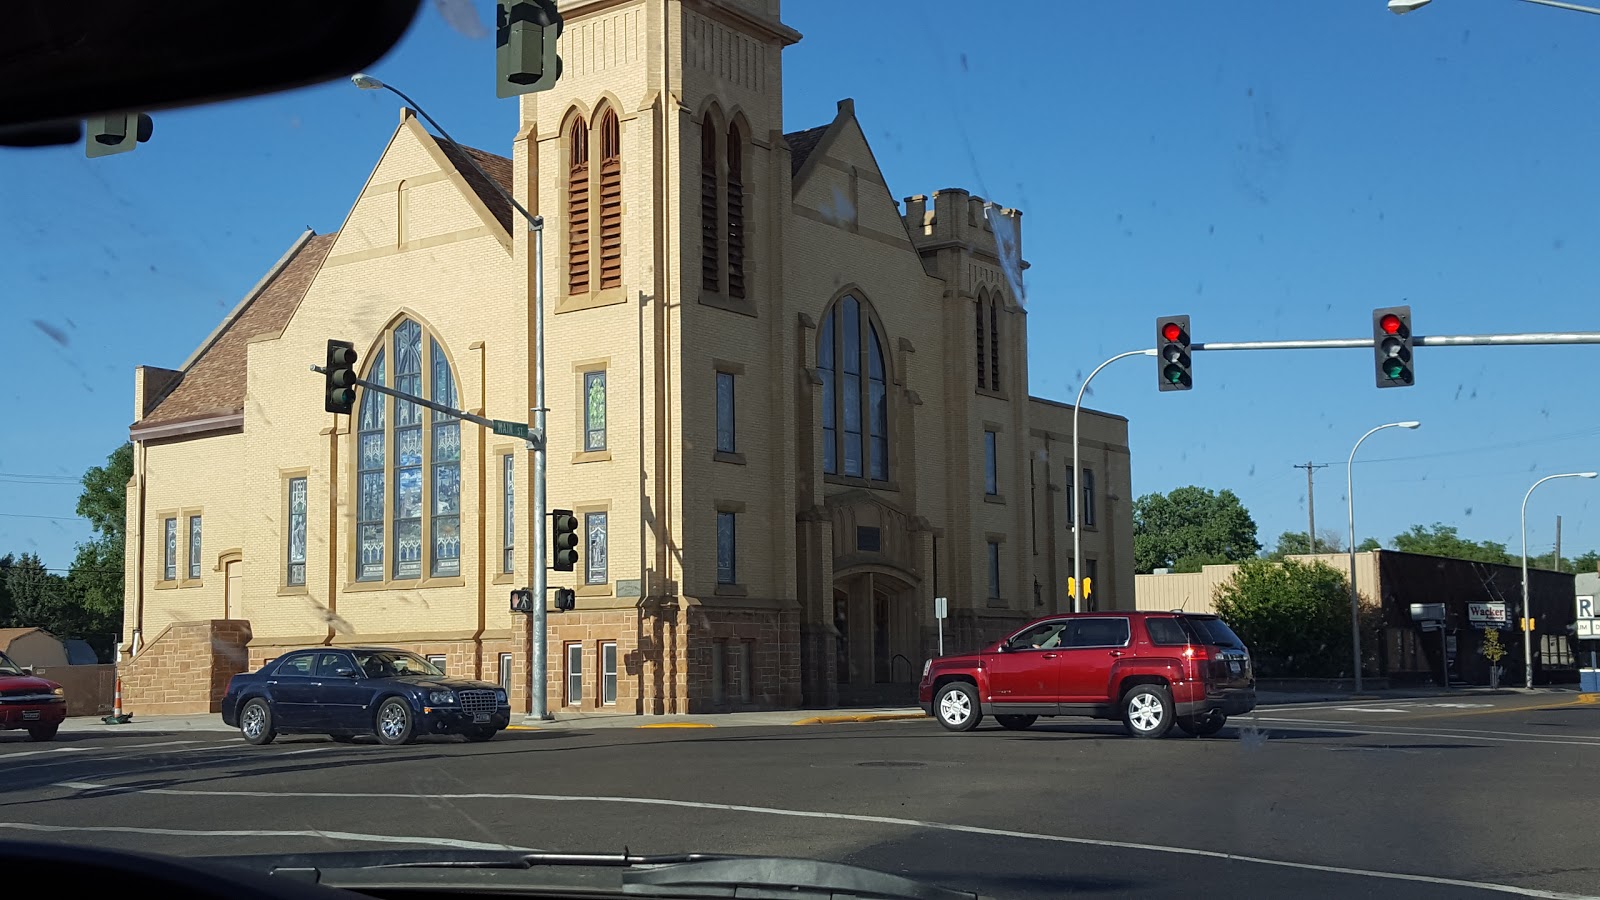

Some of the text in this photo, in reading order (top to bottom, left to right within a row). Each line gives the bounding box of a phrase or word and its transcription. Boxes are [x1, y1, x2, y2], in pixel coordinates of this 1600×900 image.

[497, 422, 523, 436] MAIN ST
[1470, 606, 1504, 616] Wacker
[1579, 599, 1592, 617] R
